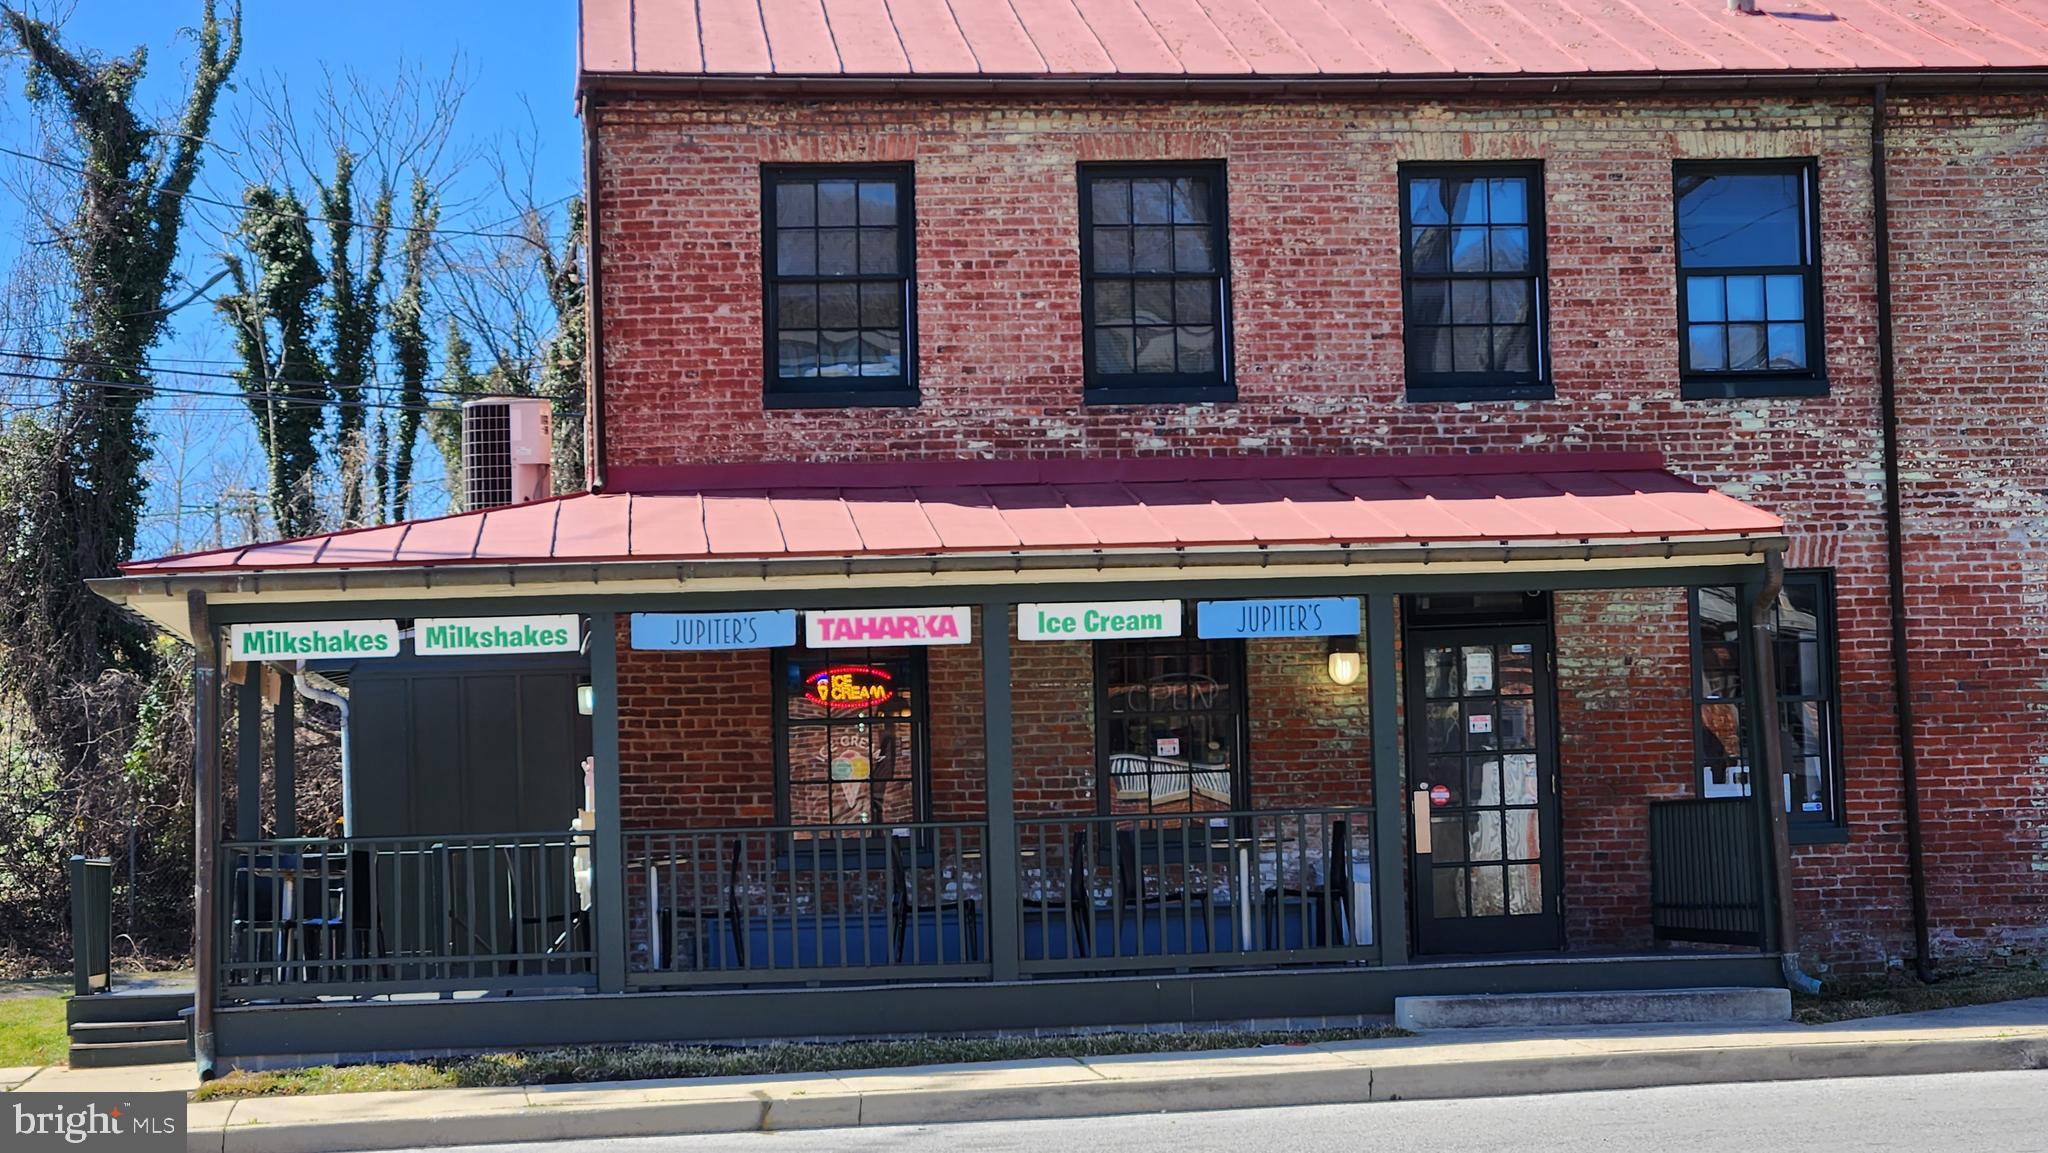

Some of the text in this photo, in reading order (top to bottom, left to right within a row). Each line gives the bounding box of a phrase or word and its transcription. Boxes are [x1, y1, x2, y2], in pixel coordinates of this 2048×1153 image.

[816, 614, 960, 642] TAHARKA
[1038, 609, 1163, 633] Ice Cream
[1236, 603, 1323, 633] JUPITER'S
[242, 628, 389, 655] Milkshakes
[425, 623, 569, 649] Milkshakes
[670, 617, 758, 646] JUPITER'S
[831, 674, 853, 687] ICE
[831, 684, 886, 701] CREAM
